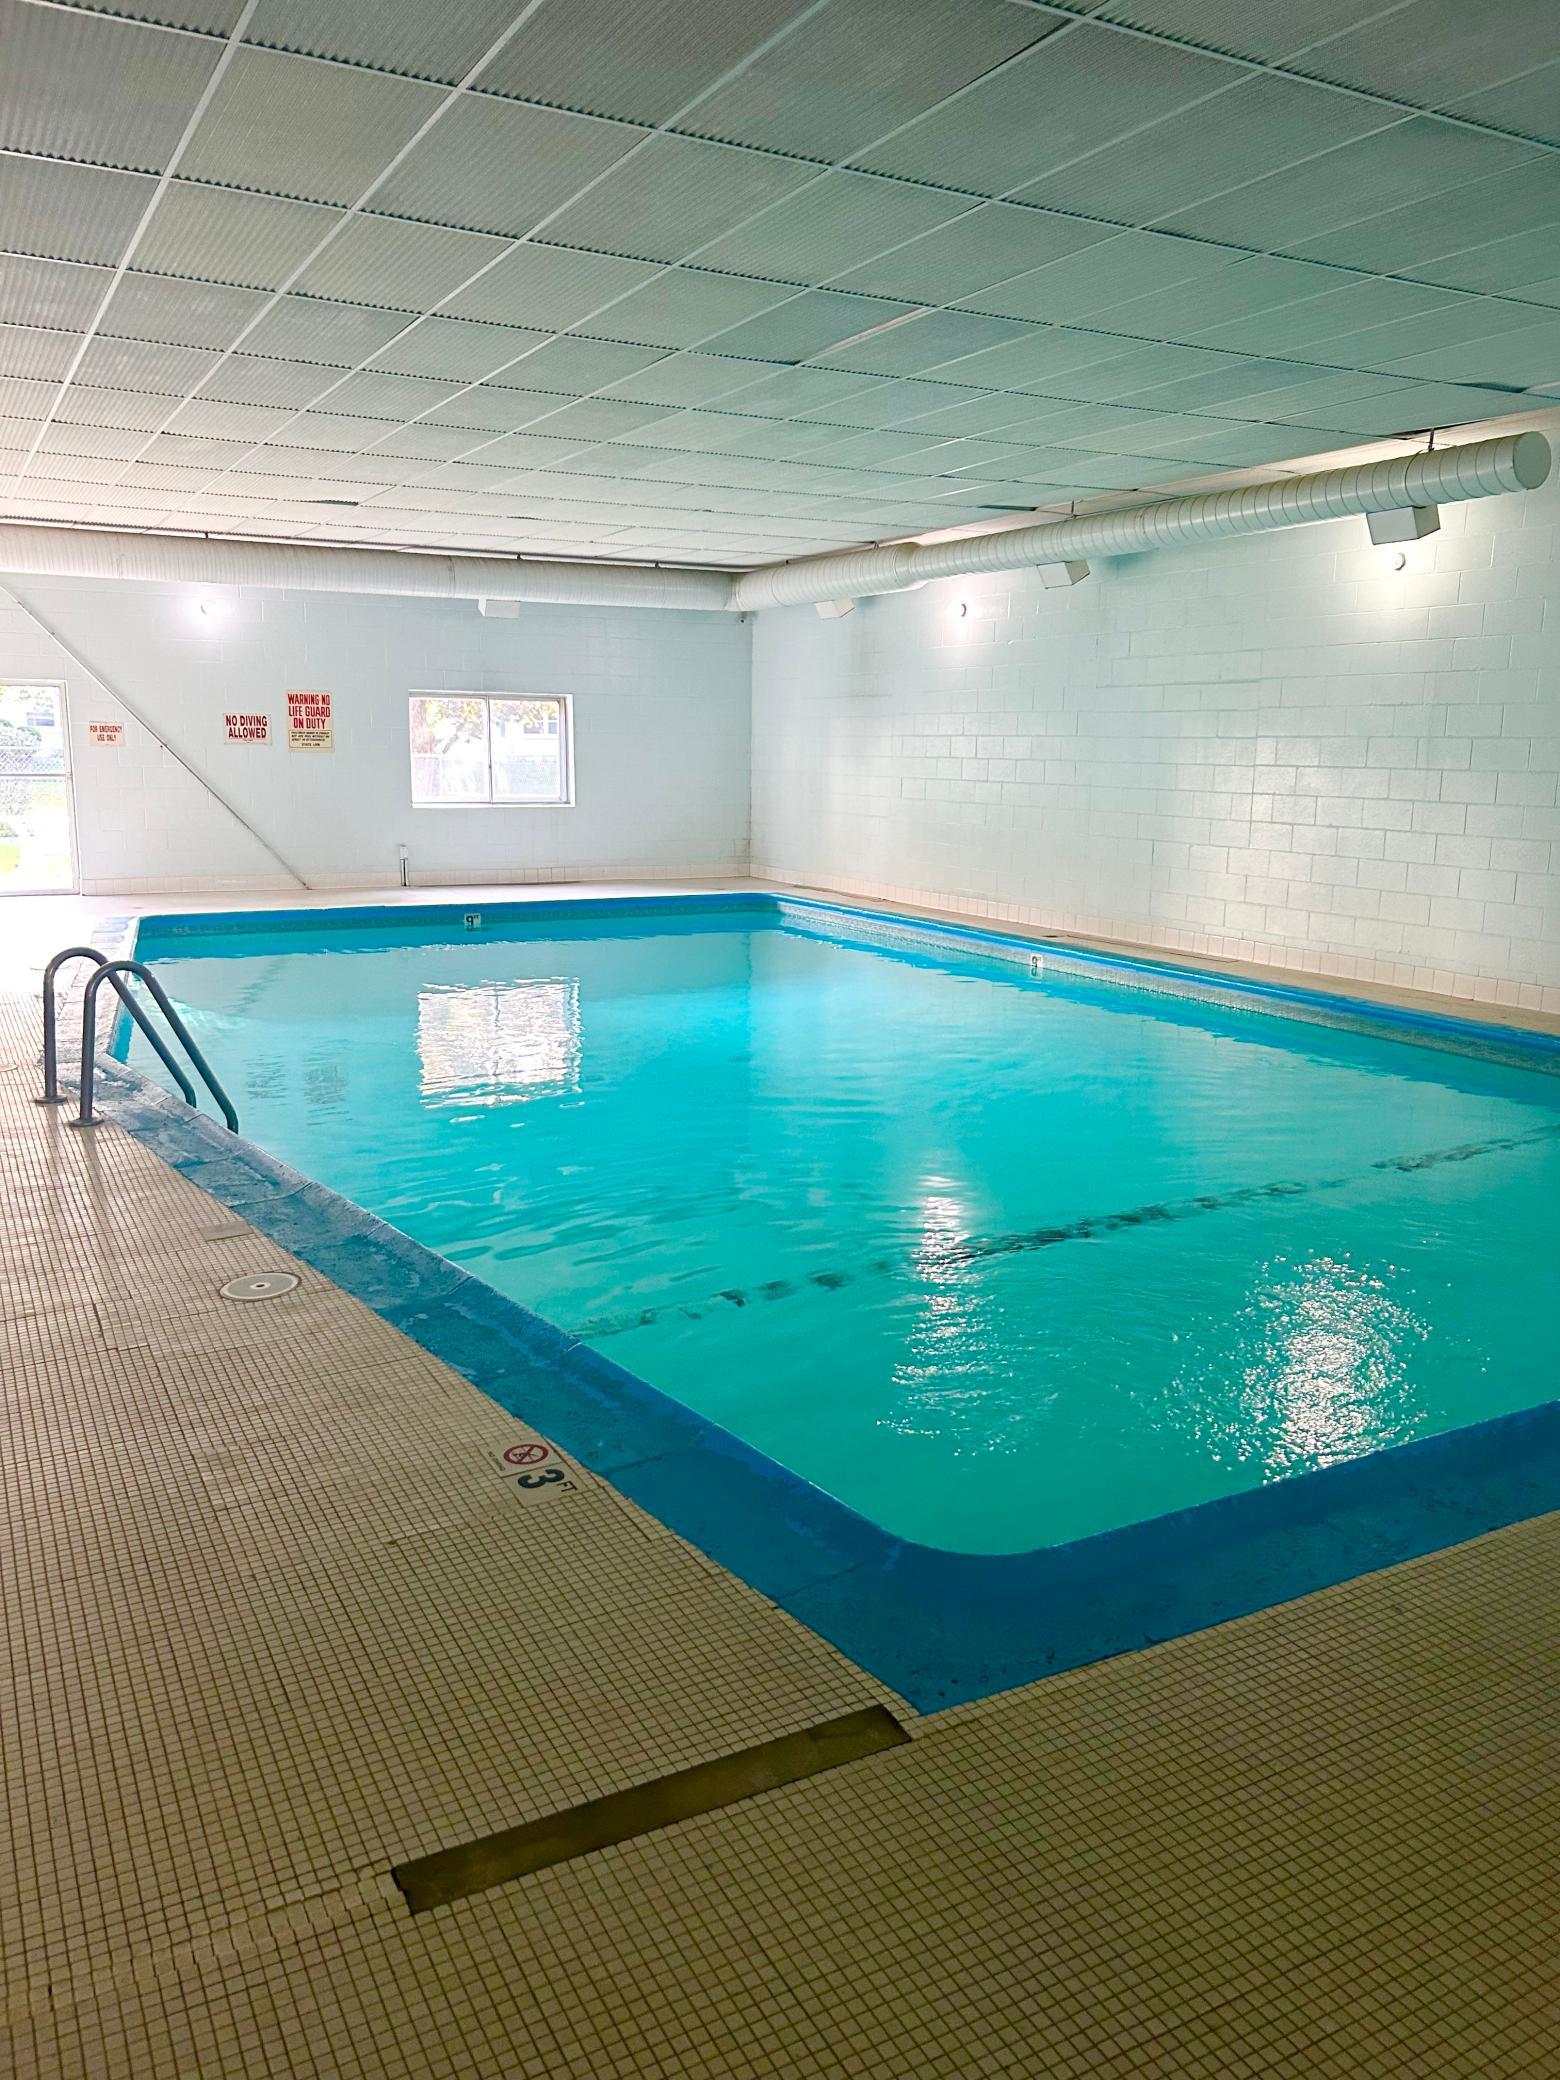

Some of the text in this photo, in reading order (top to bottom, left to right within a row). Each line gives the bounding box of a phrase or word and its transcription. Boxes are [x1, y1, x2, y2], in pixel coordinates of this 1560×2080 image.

[288, 694, 330, 705] WARNING NO
[288, 706, 331, 717] LIFE GUARD
[225, 715, 267, 726] NO DIVING
[293, 717, 326, 729] ON DUTY
[99, 725, 122, 733] EMERGENCY
[228, 727, 267, 738] ALLOWED
[466, 915, 473, 925] 9
[1031, 956, 1037, 967] 9
[517, 1468, 578, 1492] 3 FT
